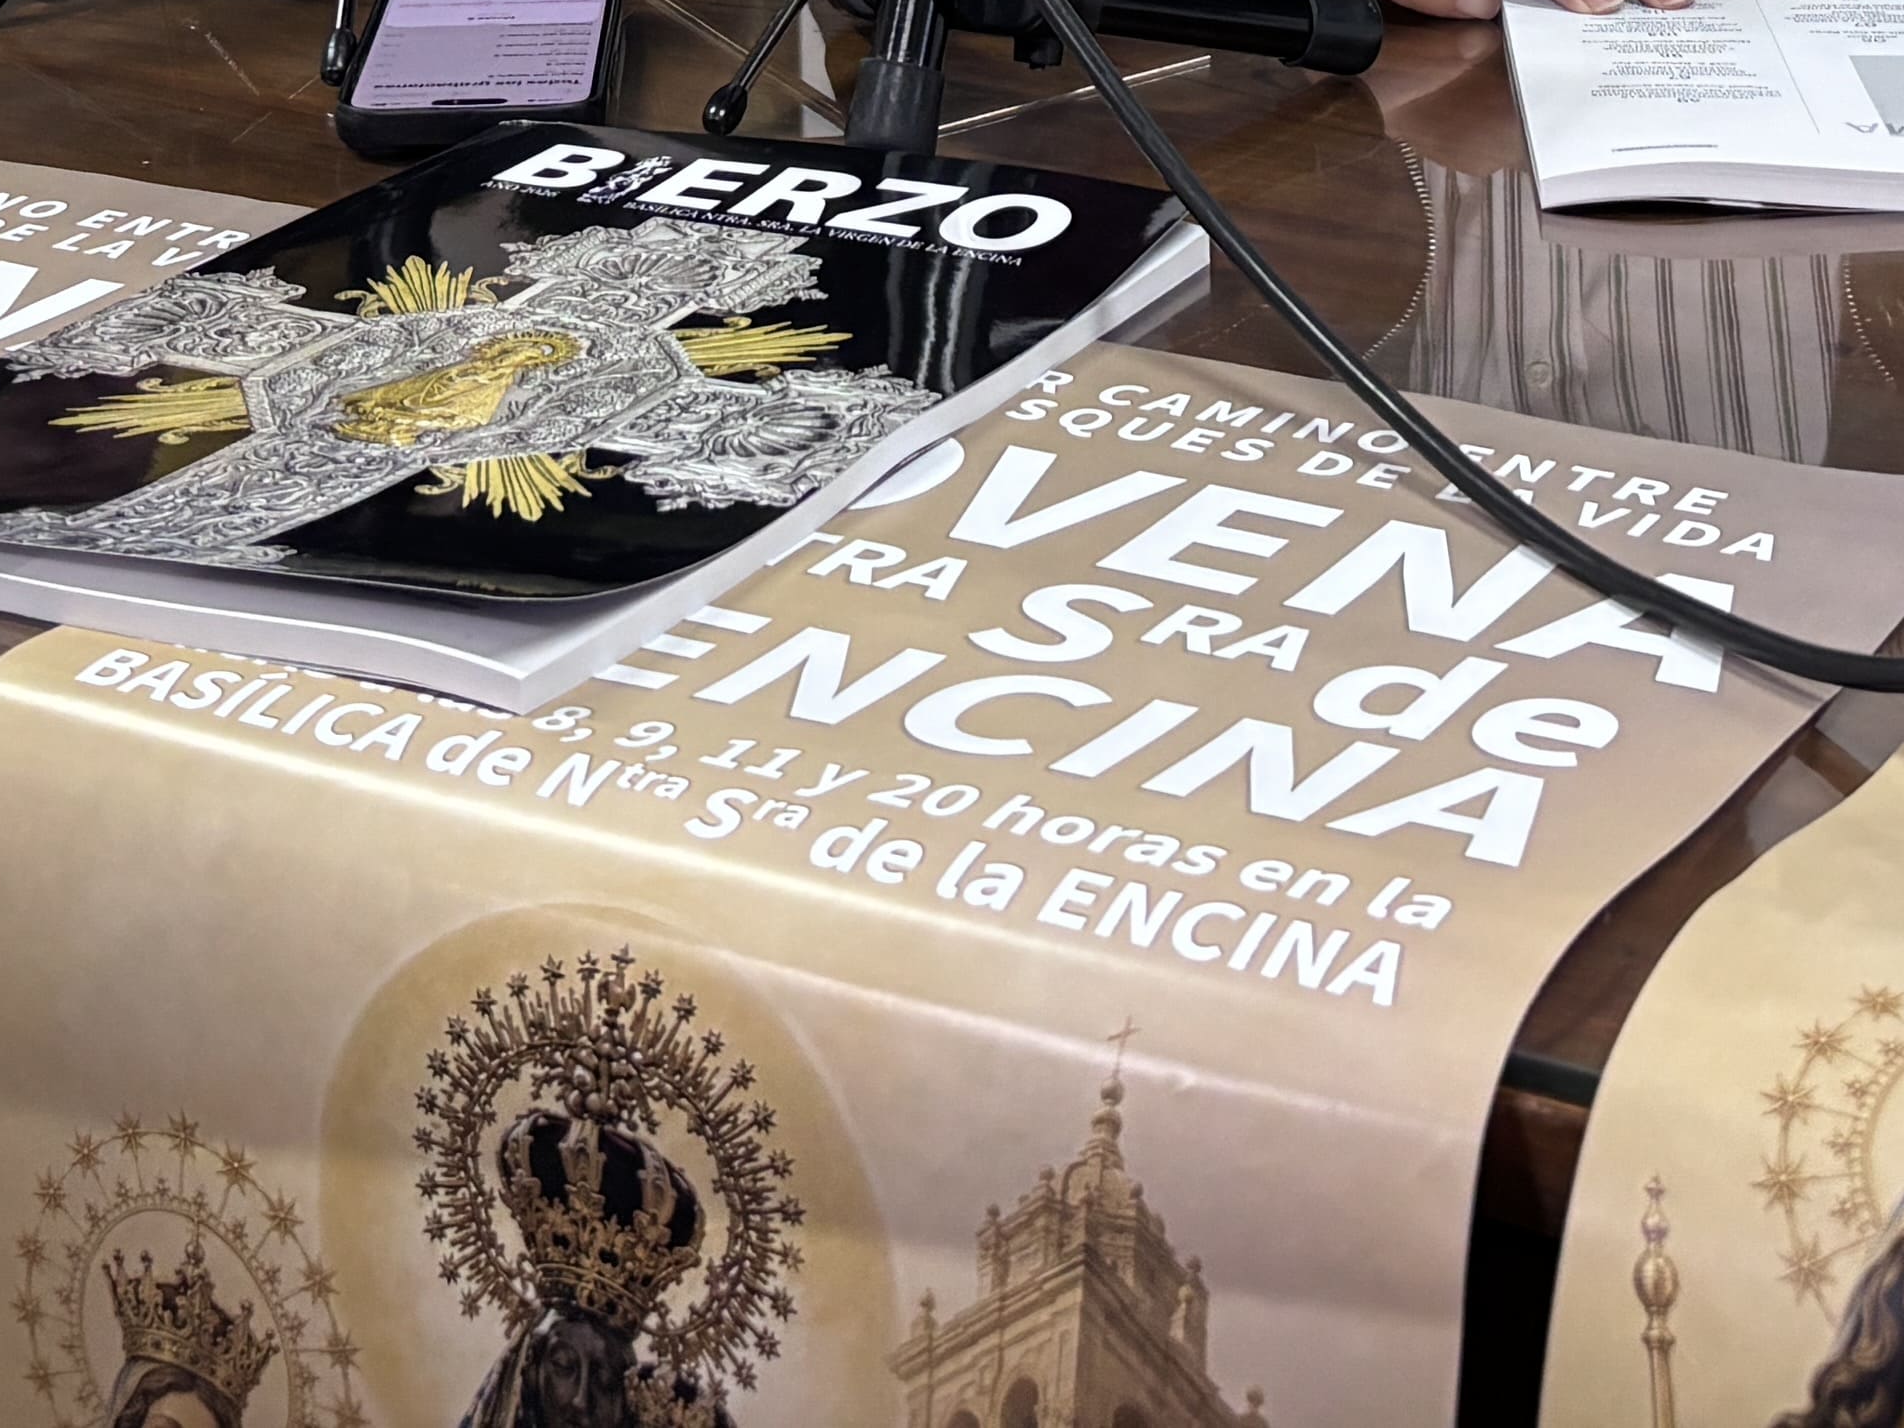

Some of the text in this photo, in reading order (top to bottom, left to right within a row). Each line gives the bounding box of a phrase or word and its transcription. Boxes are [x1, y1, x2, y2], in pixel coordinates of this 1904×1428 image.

[55, 231, 139, 262] LA
[83, 208, 253, 251] ENTR
[491, 143, 1073, 252] BIERZO
[1003, 396, 1778, 564] SQUES DE VIDA
[1097, 383, 1411, 456] CAMINO
[766, 530, 969, 602] TRA
[1312, 655, 1621, 768] de
[844, 437, 1737, 694] VENA
[74, 647, 424, 762] BASÍLICA
[425, 729, 534, 789] de
[807, 816, 927, 885] de
[933, 838, 1025, 914] la
[1035, 865, 1405, 1009] ENCINA
[531, 704, 1455, 933] 8, 9, 11 y 20 horas en la
[591, 604, 1546, 868] ENCINA
